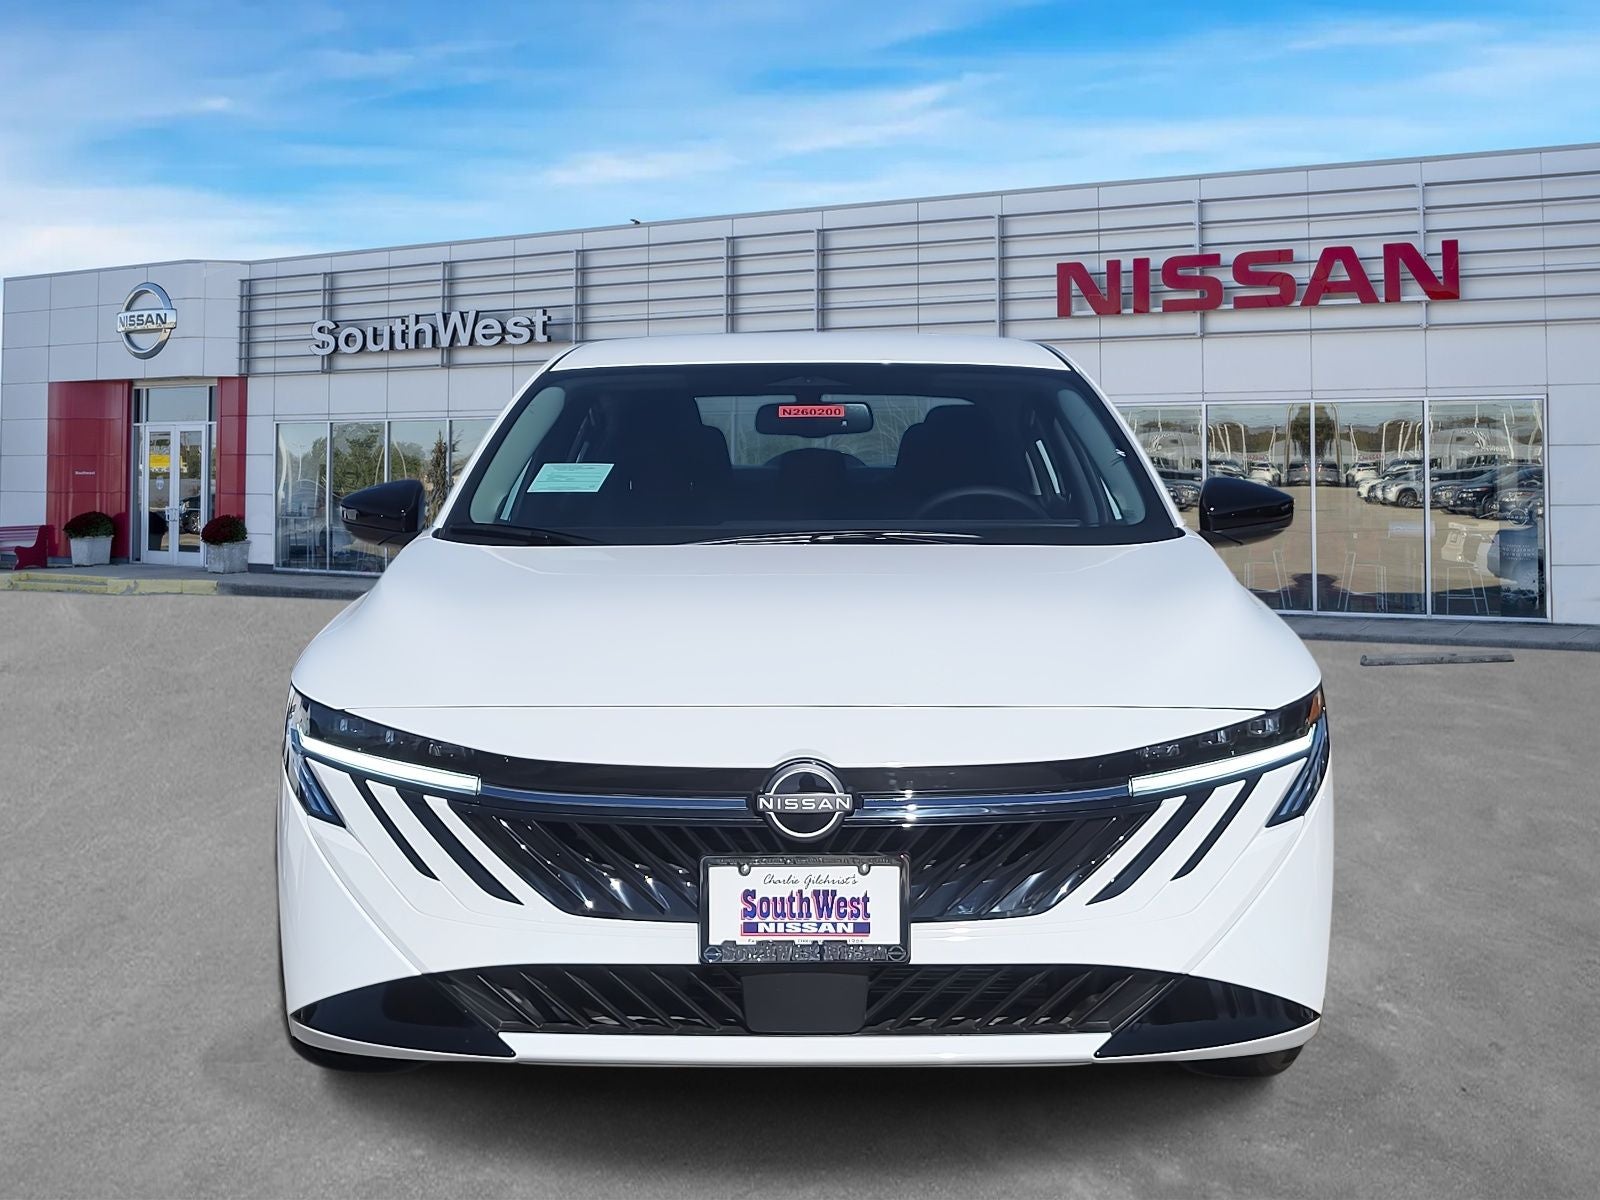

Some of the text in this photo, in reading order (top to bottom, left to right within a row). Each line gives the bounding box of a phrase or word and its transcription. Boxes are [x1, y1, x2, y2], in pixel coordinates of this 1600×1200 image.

[1056, 239, 1460, 319] NISSAN
[119, 312, 167, 328] NISSAN
[309, 309, 552, 356] SouthWest
[782, 408, 841, 416] N260200
[759, 797, 850, 811] NISSAN
[763, 873, 859, 890] Charlie Gilchrist's
[740, 888, 871, 920] SouthWest
[757, 922, 855, 934] NISSAN
